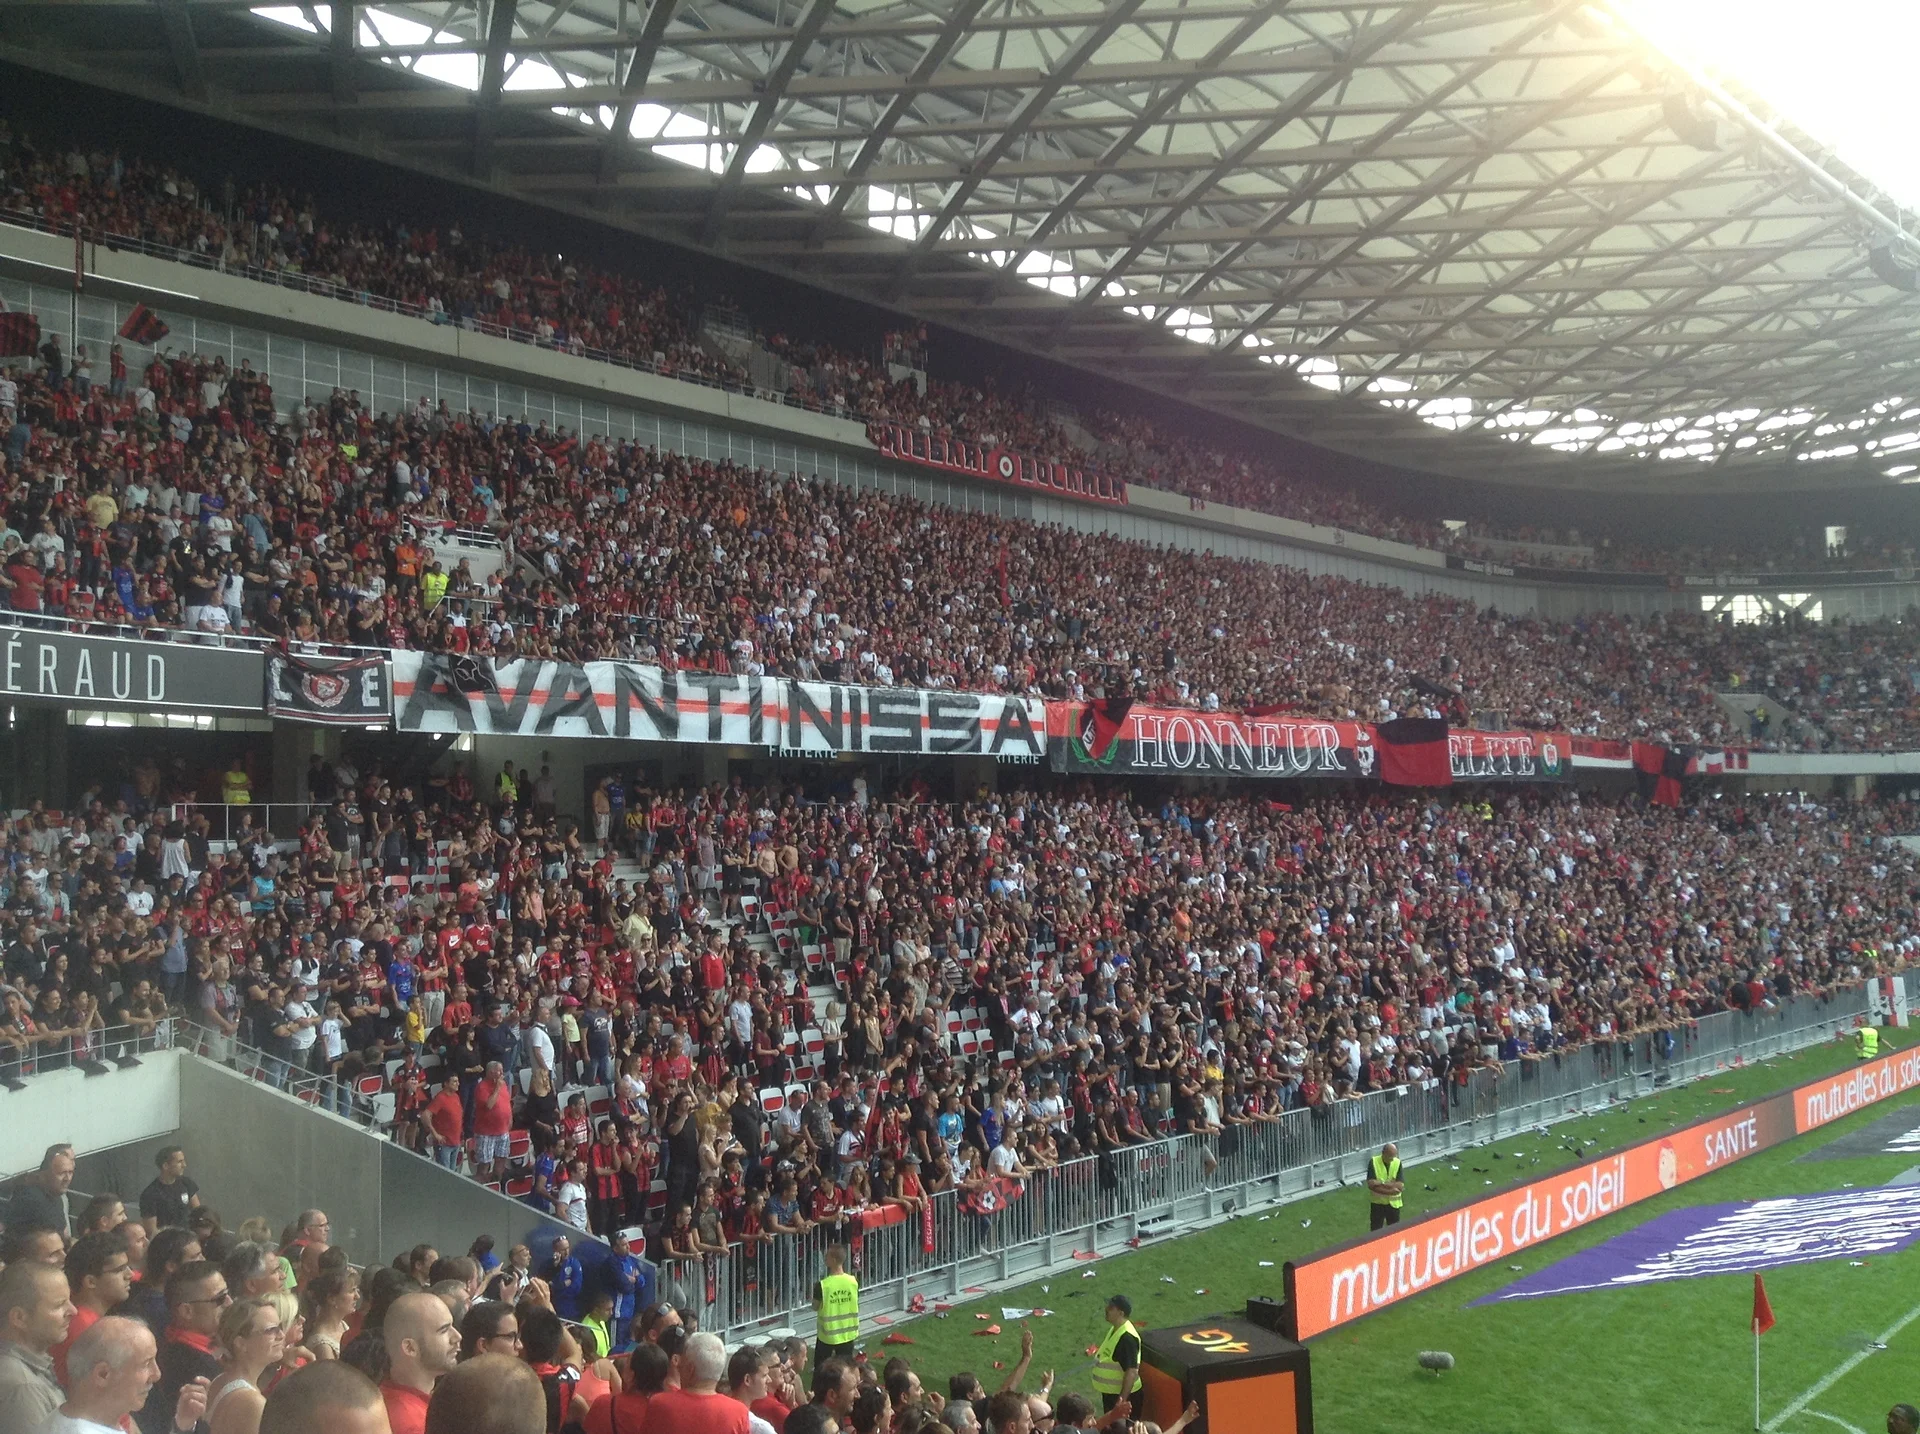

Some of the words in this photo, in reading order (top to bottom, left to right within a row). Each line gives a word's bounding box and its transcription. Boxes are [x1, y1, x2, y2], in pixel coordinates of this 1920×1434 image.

[6, 632, 166, 701] ÉRAUD
[1129, 714, 1340, 772] HONNEUR
[1806, 1068, 1877, 1126] mutuelles
[1880, 1060, 1897, 1097] du
[1330, 1206, 1503, 1321] mutuelles
[1511, 1188, 1552, 1249] du
[1560, 1157, 1626, 1231] soleil
[1705, 1111, 1758, 1167] SANTÉ
